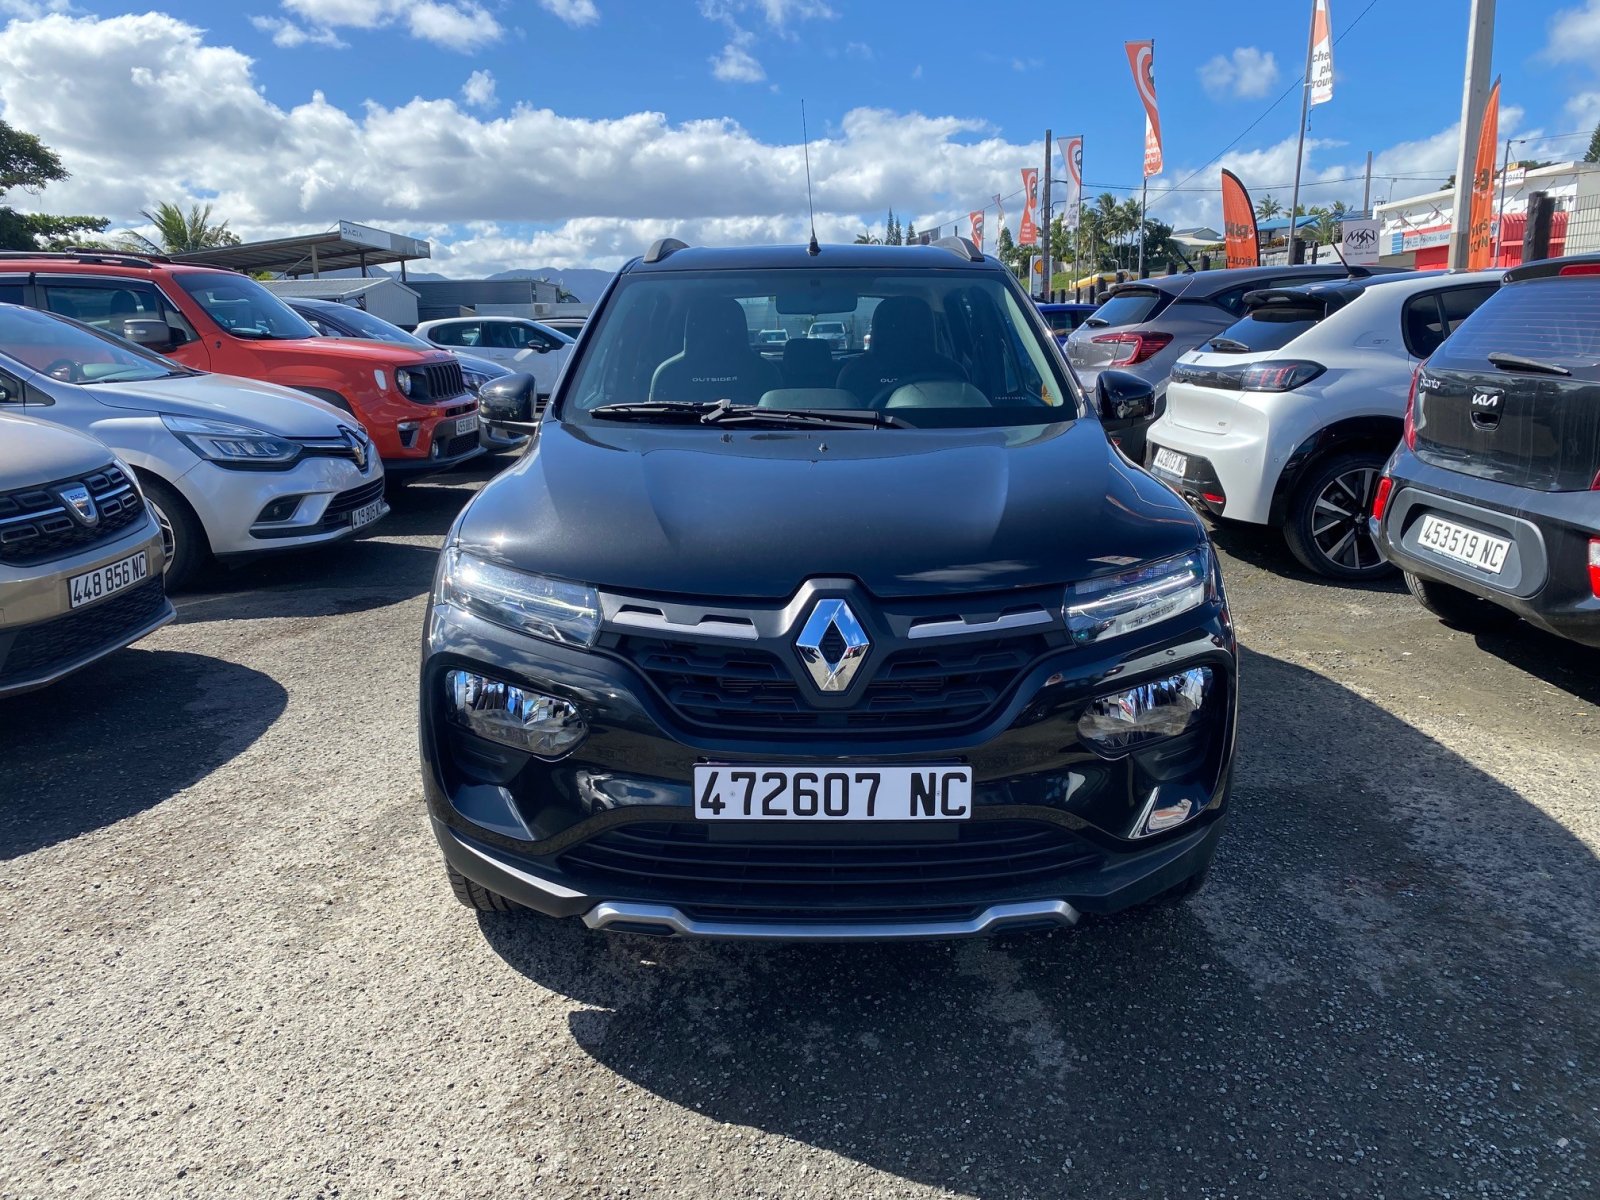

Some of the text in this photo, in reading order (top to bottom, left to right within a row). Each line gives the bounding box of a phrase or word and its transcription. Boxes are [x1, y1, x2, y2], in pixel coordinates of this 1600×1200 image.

[1472, 393, 1499, 406] KIA
[1423, 521, 1479, 559] 453519
[1480, 539, 1503, 567] NC
[73, 554, 146, 603] 448 856 NC
[700, 771, 968, 817] 472607 NC
